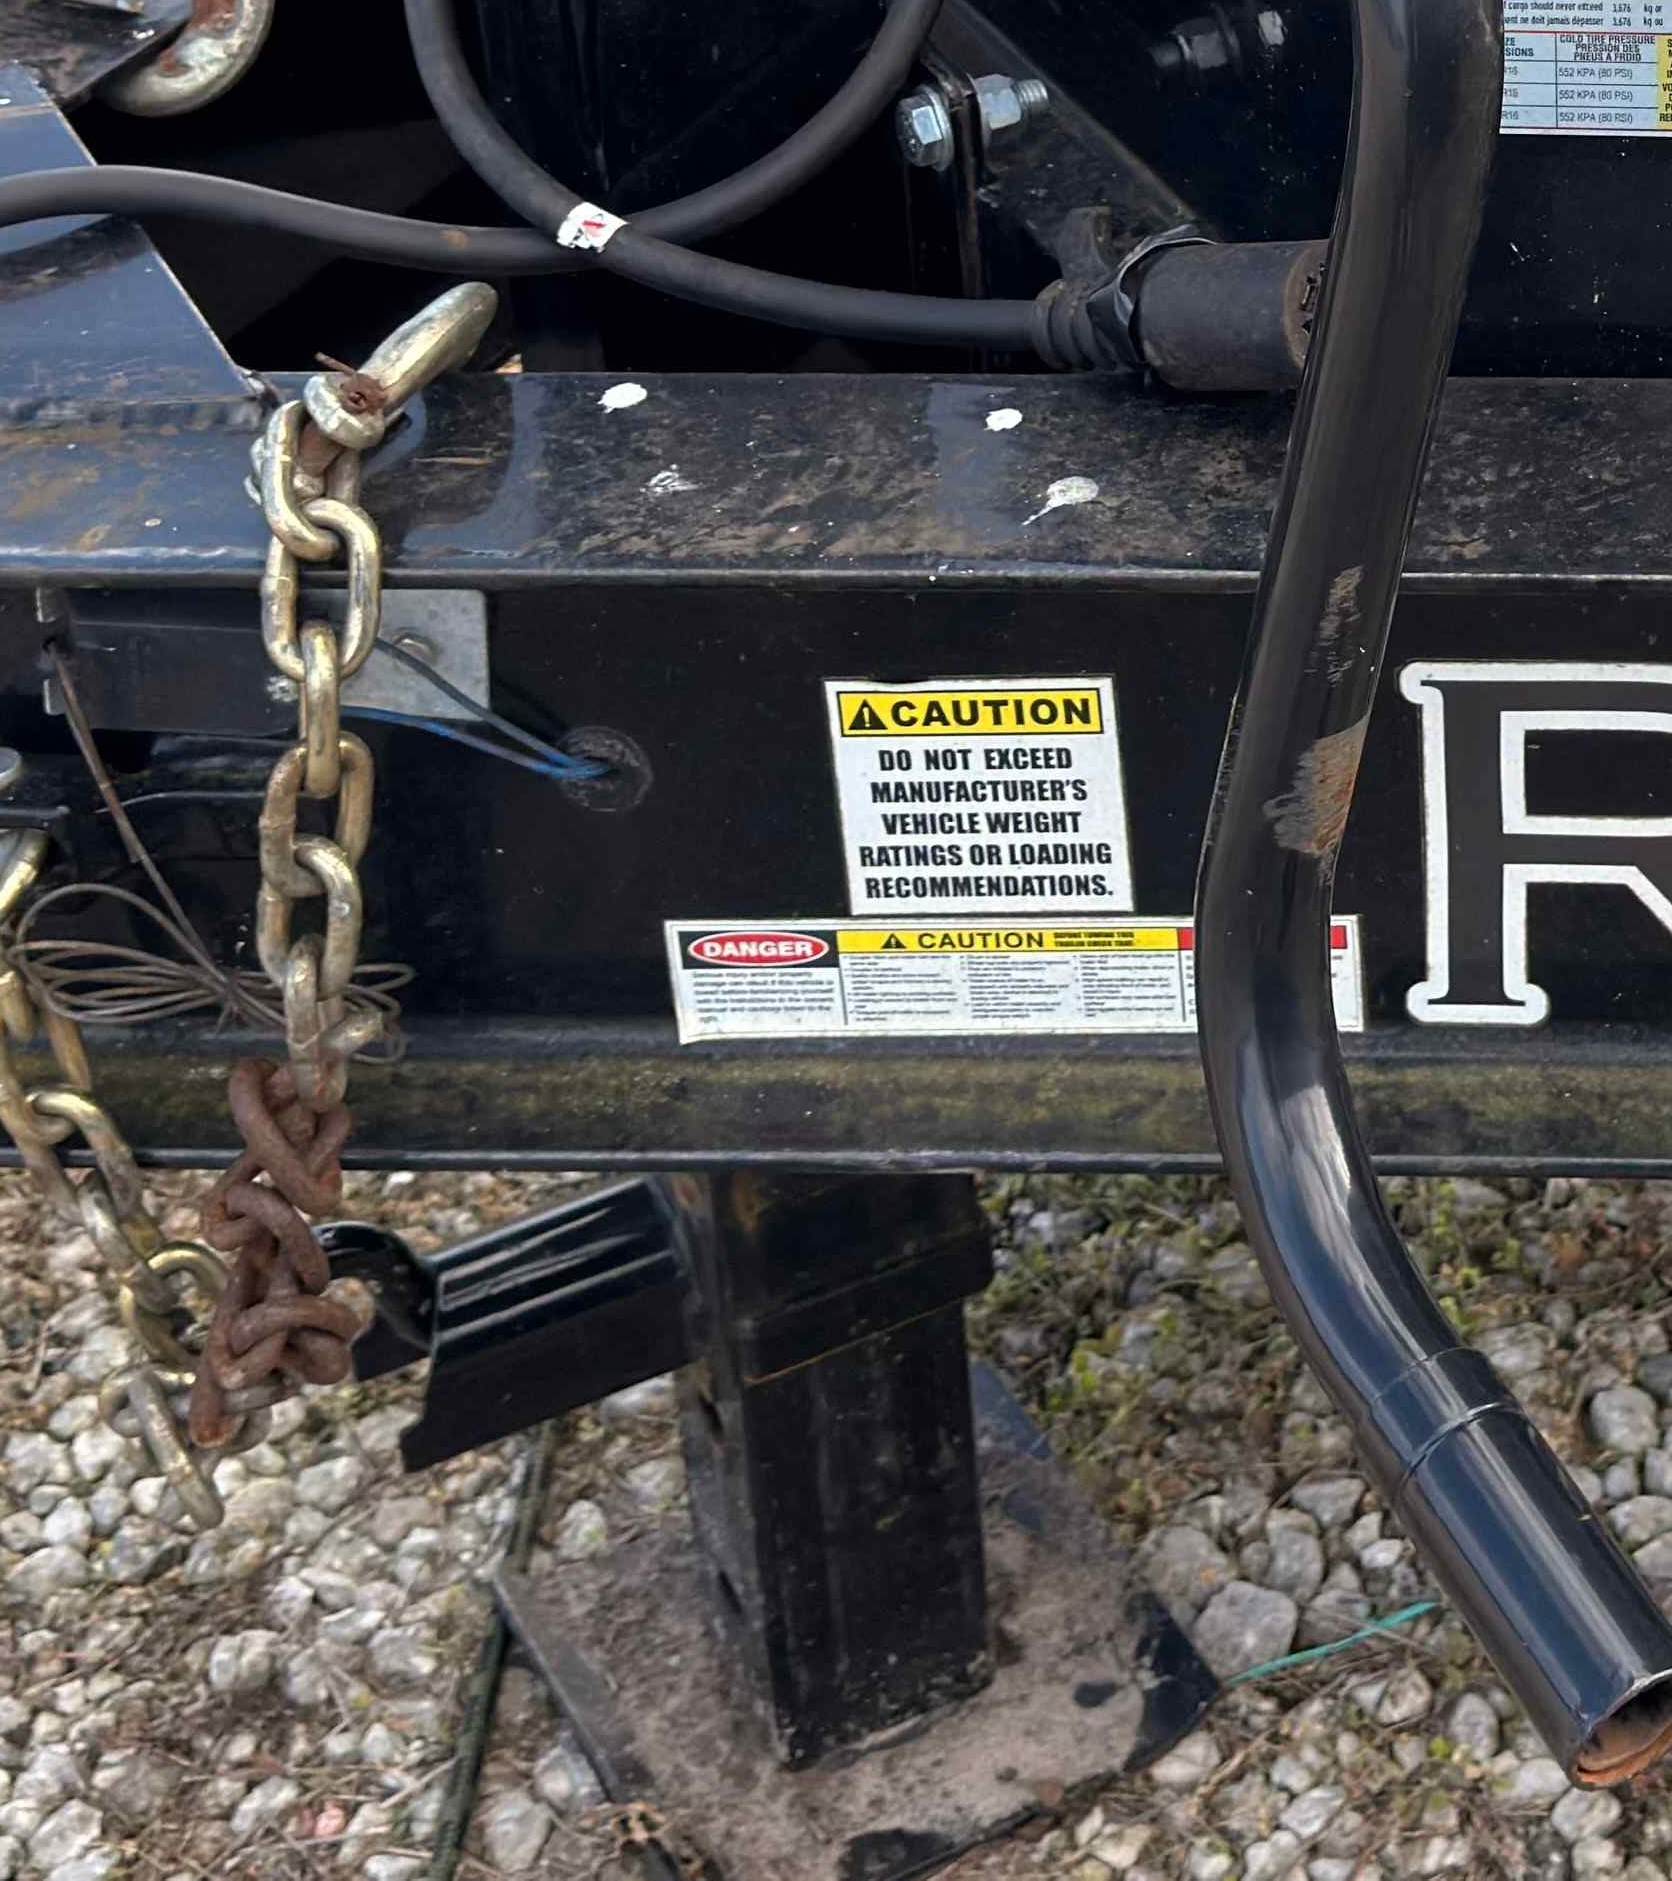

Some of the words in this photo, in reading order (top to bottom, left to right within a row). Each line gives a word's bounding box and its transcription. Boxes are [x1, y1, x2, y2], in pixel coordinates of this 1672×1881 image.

[1530, 1, 1554, 10] should
[1560, 34, 1584, 43] COLD
[1587, 35, 1607, 44] TIRE
[1609, 35, 1655, 44] PRESSURE
[1505, 47, 1534, 57] SIONS
[1576, 43, 1620, 52] PRESSION
[1623, 44, 1640, 53] DES
[1574, 52, 1603, 61] PNEUS
[1614, 53, 1642, 62] FROID
[1559, 67, 1575, 77] 552
[1577, 68, 1595, 77] KPA
[1559, 90, 1575, 100] 552
[1577, 90, 1595, 100] KPA
[1559, 112, 1575, 122] 552
[1577, 112, 1596, 122] KPA
[891, 698, 1092, 727] CAUTION
[878, 749, 912, 771] DO
[925, 748, 971, 771] NOT
[984, 747, 1072, 770] EXCEED
[871, 779, 1088, 803] MANUFACTURER'S
[881, 813, 979, 835] VEHICLE
[985, 811, 1082, 834] WEIGHT
[859, 845, 962, 867] RATINGS
[969, 844, 1003, 866] OR
[1009, 842, 1112, 865] LOADING
[865, 874, 1114, 899] RECOMMENDATIONS.
[918, 932, 1044, 950] CAUTION
[702, 941, 814, 958] DANGER
